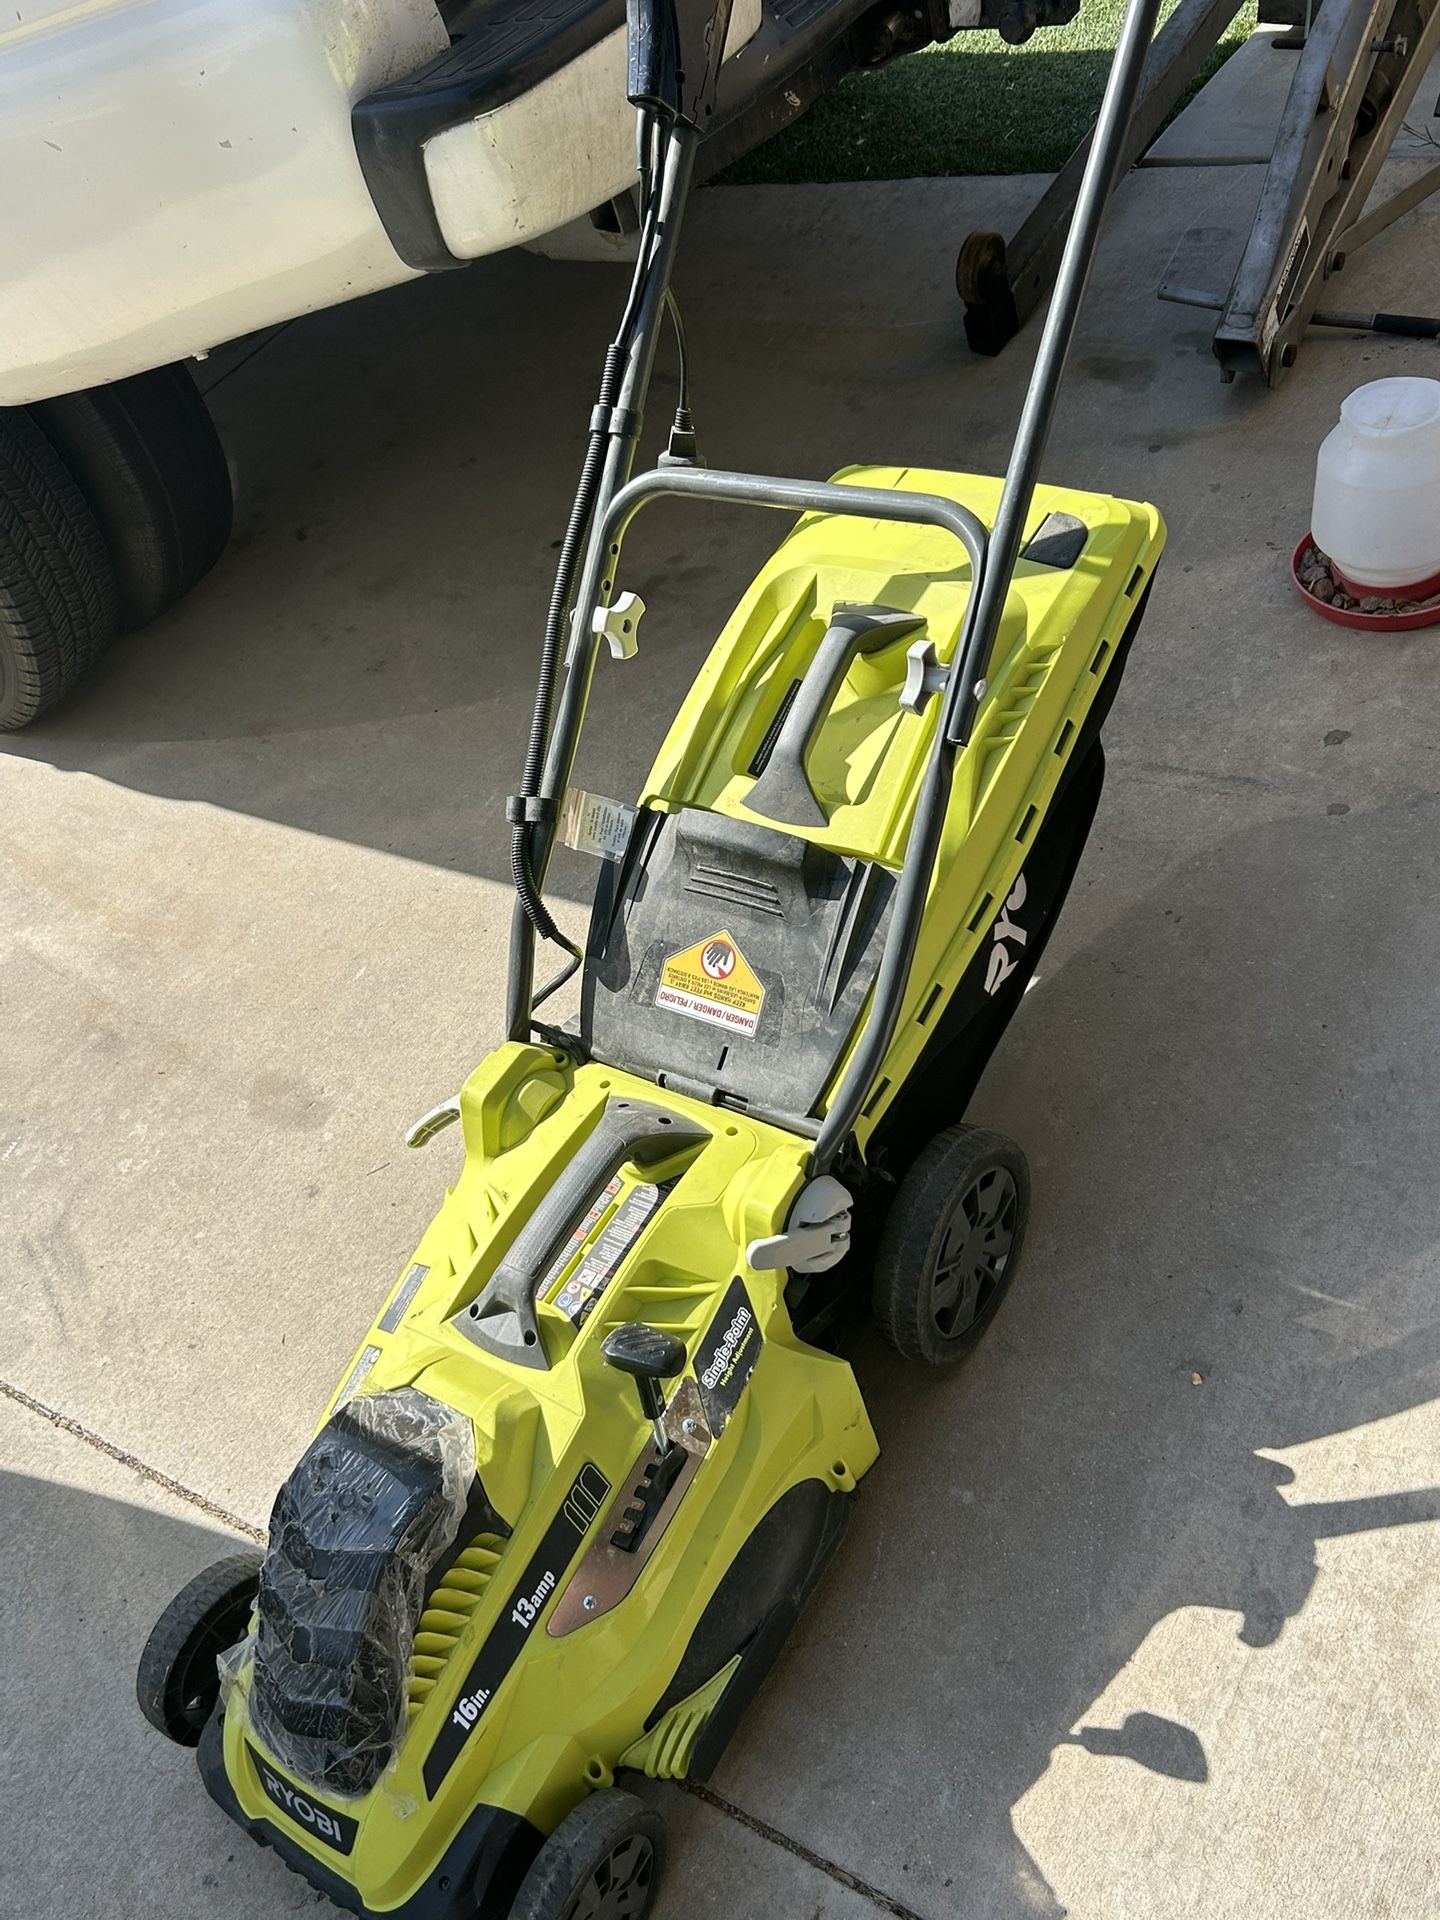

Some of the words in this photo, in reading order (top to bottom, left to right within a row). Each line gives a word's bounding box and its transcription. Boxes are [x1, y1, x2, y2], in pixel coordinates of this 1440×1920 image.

[674, 980, 689, 989] AWAY
[689, 985, 702, 993] FEET
[660, 992, 688, 1007] PELIGRO
[702, 989, 712, 997] and
[712, 992, 731, 1002] HANDS
[732, 998, 745, 1007] KEEP
[693, 1003, 721, 1017] DANGER
[725, 1012, 754, 1028] DANGER
[702, 1307, 752, 1389] Single-Point
[720, 1363, 735, 1386] Height
[732, 1327, 754, 1364] Adjustment
[453, 1688, 491, 1730] 16in.
[512, 1570, 555, 1628] 13amp
[263, 1767, 342, 1842] RYOBI
